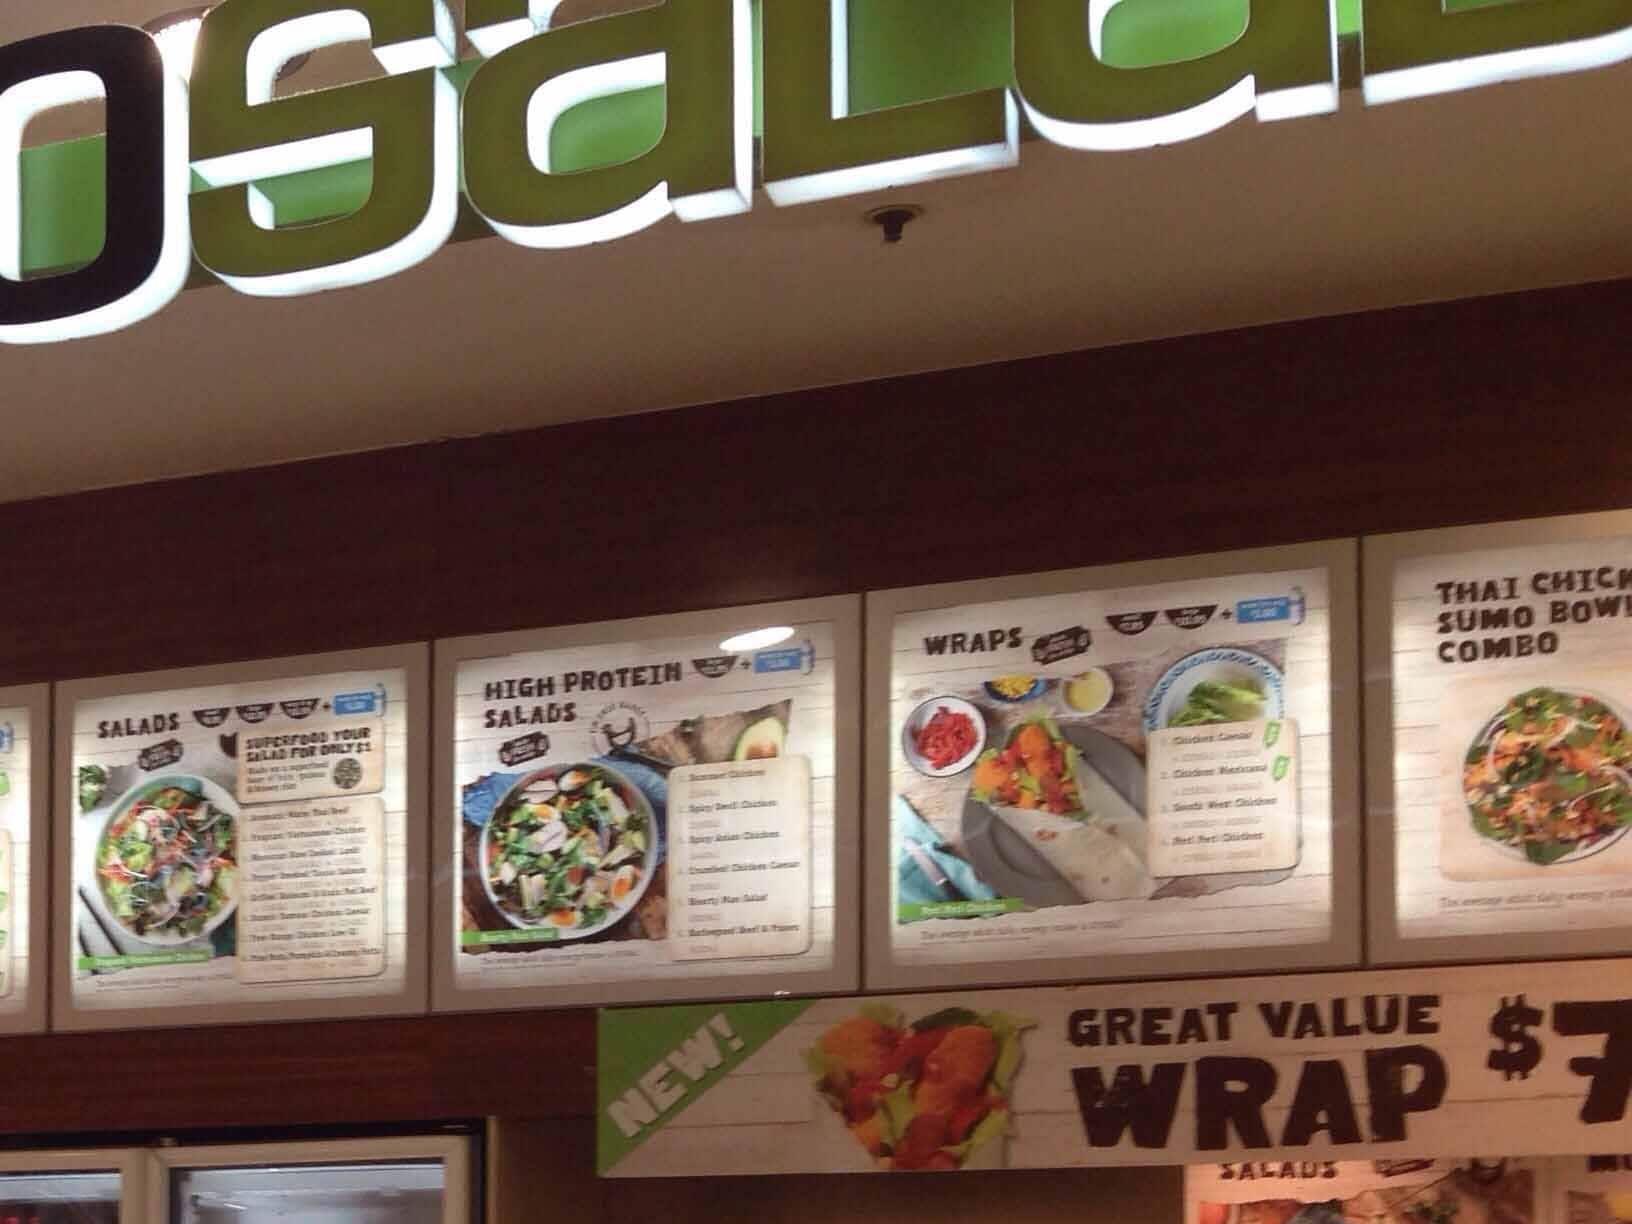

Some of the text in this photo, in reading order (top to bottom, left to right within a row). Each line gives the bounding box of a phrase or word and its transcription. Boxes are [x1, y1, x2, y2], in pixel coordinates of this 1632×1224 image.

[1436, 576, 1520, 604] THAI
[1437, 605, 1535, 634] SUMO
[924, 627, 1023, 656] WRAPS
[1438, 631, 1559, 663] COMBO
[484, 661, 683, 701] HIGH PROTEIN
[97, 712, 181, 739] SALADS
[484, 702, 577, 729] SALADS
[245, 727, 371, 750] SUPERFOOD YOUR
[246, 748, 287, 763] SALAD
[290, 745, 317, 760] FOR
[320, 742, 353, 756] ONLY
[1068, 994, 1441, 1047] GREAT VALUE
[607, 1012, 745, 1138] NEW!
[1071, 1043, 1448, 1151] WRAP
